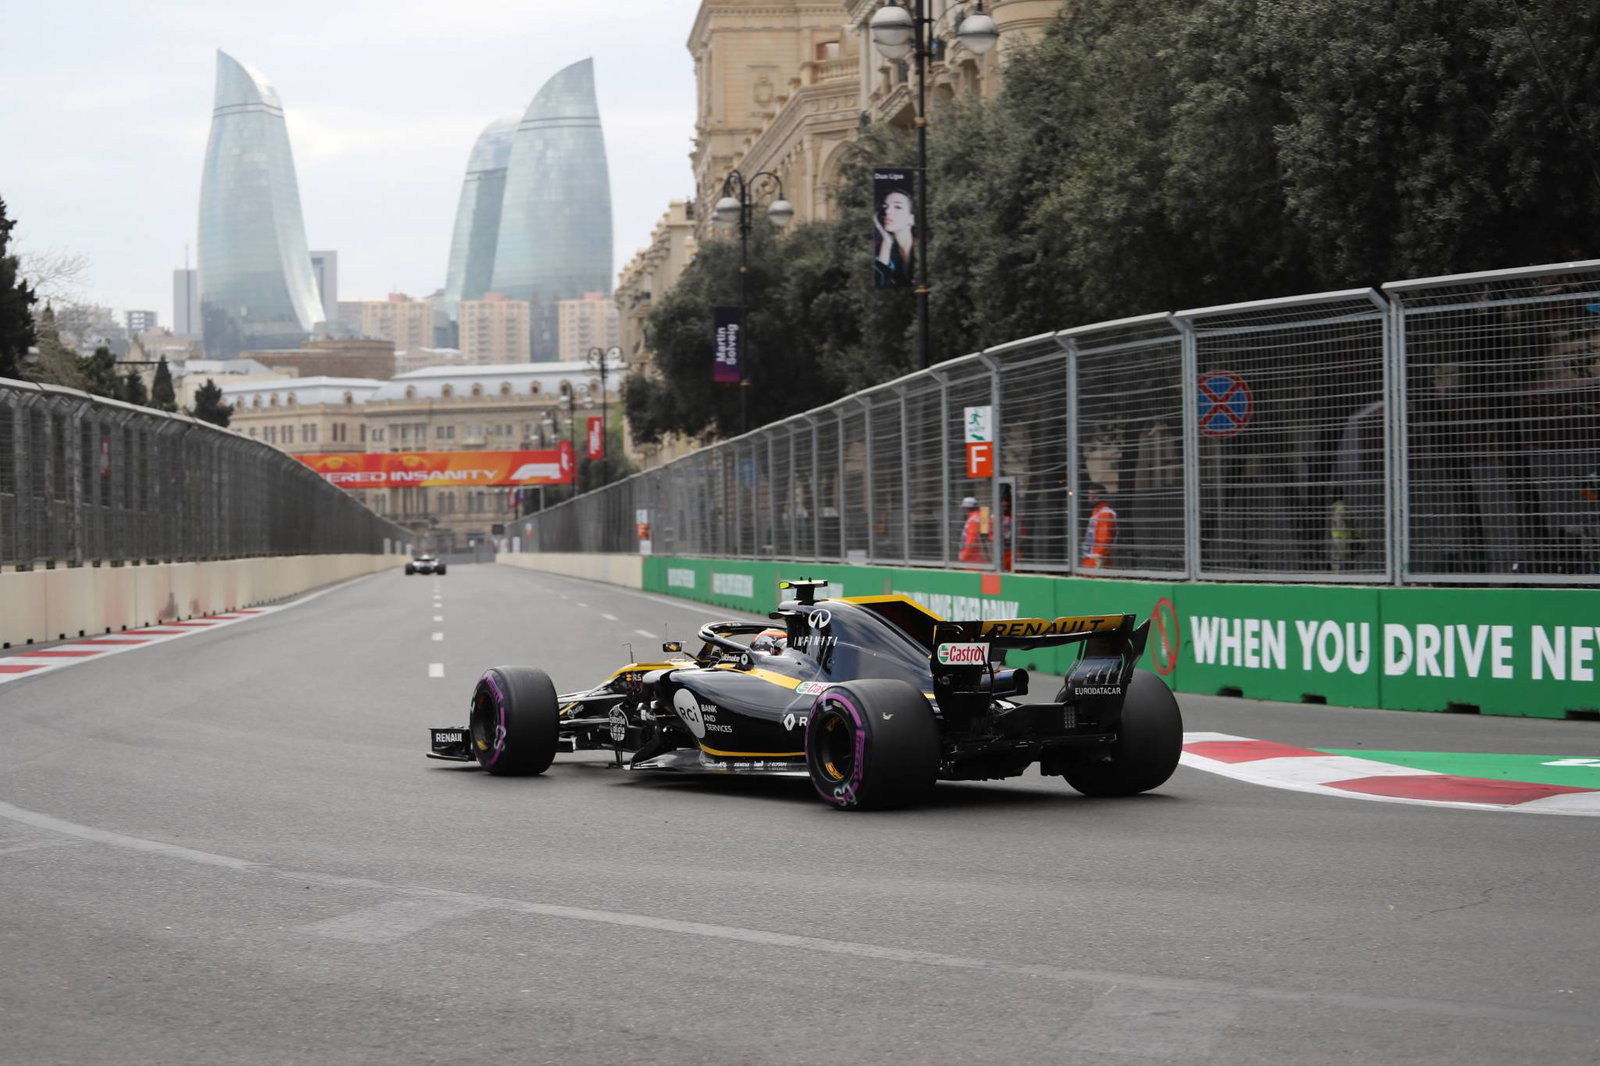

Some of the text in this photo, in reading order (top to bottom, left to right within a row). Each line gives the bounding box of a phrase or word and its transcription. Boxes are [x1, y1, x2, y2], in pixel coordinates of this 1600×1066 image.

[716, 327, 727, 362] Martin
[726, 323, 739, 365] Solveig
[971, 445, 988, 474] F
[320, 471, 387, 482] ERED
[390, 469, 498, 481] INSANITY
[989, 621, 1104, 637] RENAULT
[793, 636, 838, 647] INFINITI
[949, 646, 986, 662] Castrol
[1190, 616, 1600, 682] WHEN YOU DRIVE NE
[1074, 687, 1121, 695] EURODATACAR
[701, 704, 717, 713] BANK
[703, 714, 716, 722] AND
[706, 723, 733, 733] SERVICES
